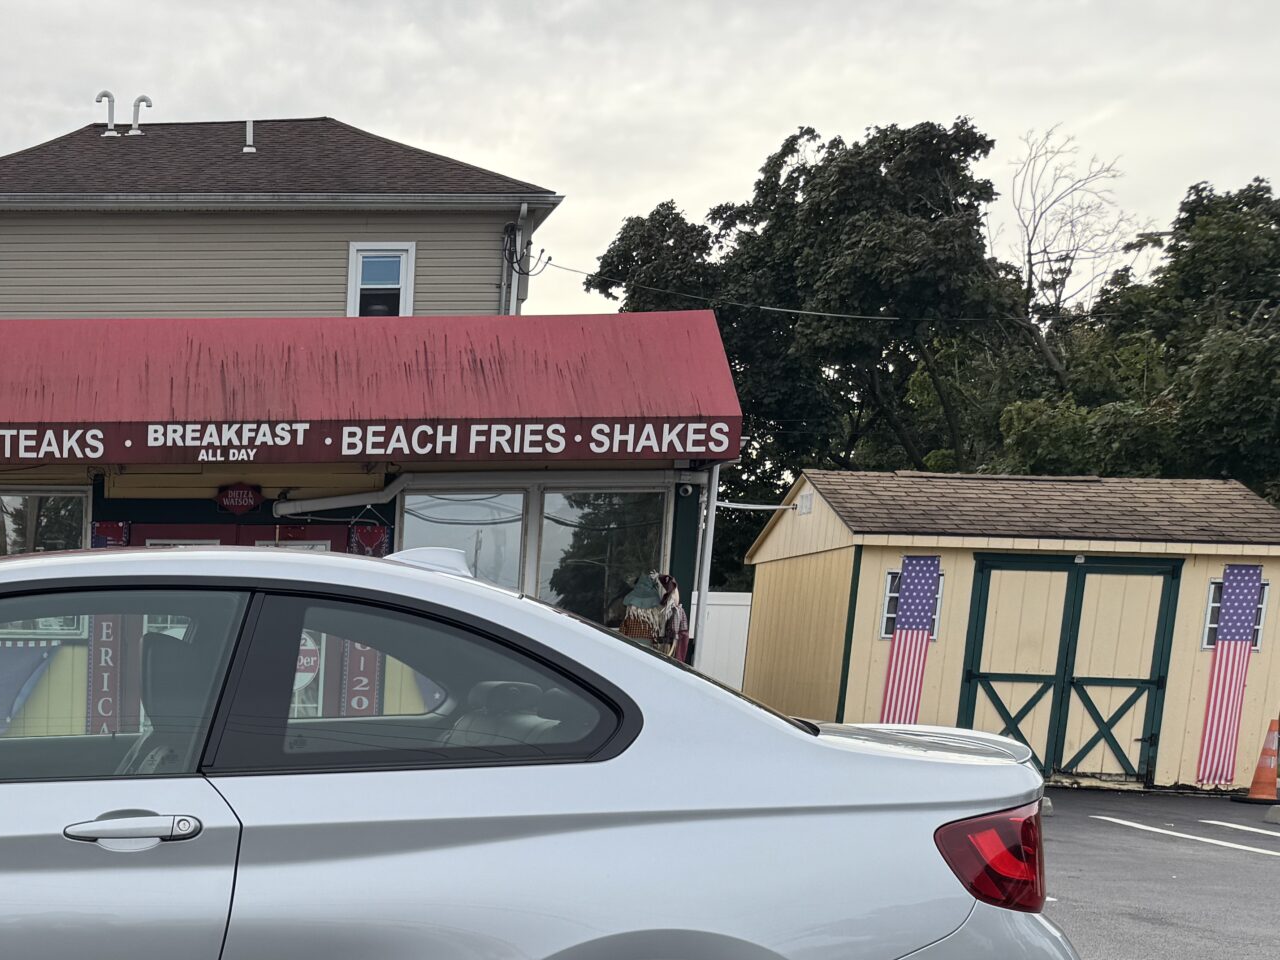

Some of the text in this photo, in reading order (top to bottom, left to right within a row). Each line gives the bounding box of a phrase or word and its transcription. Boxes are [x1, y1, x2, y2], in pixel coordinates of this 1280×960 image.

[147, 423, 310, 447] BREAKFAST
[341, 424, 458, 456] BEACH
[469, 423, 567, 454] FRIES
[589, 422, 730, 454] SHAKES
[198, 448, 257, 461] ALL DAY
[223, 498, 254, 506] WATSON
[97, 621, 114, 735] ERICA
